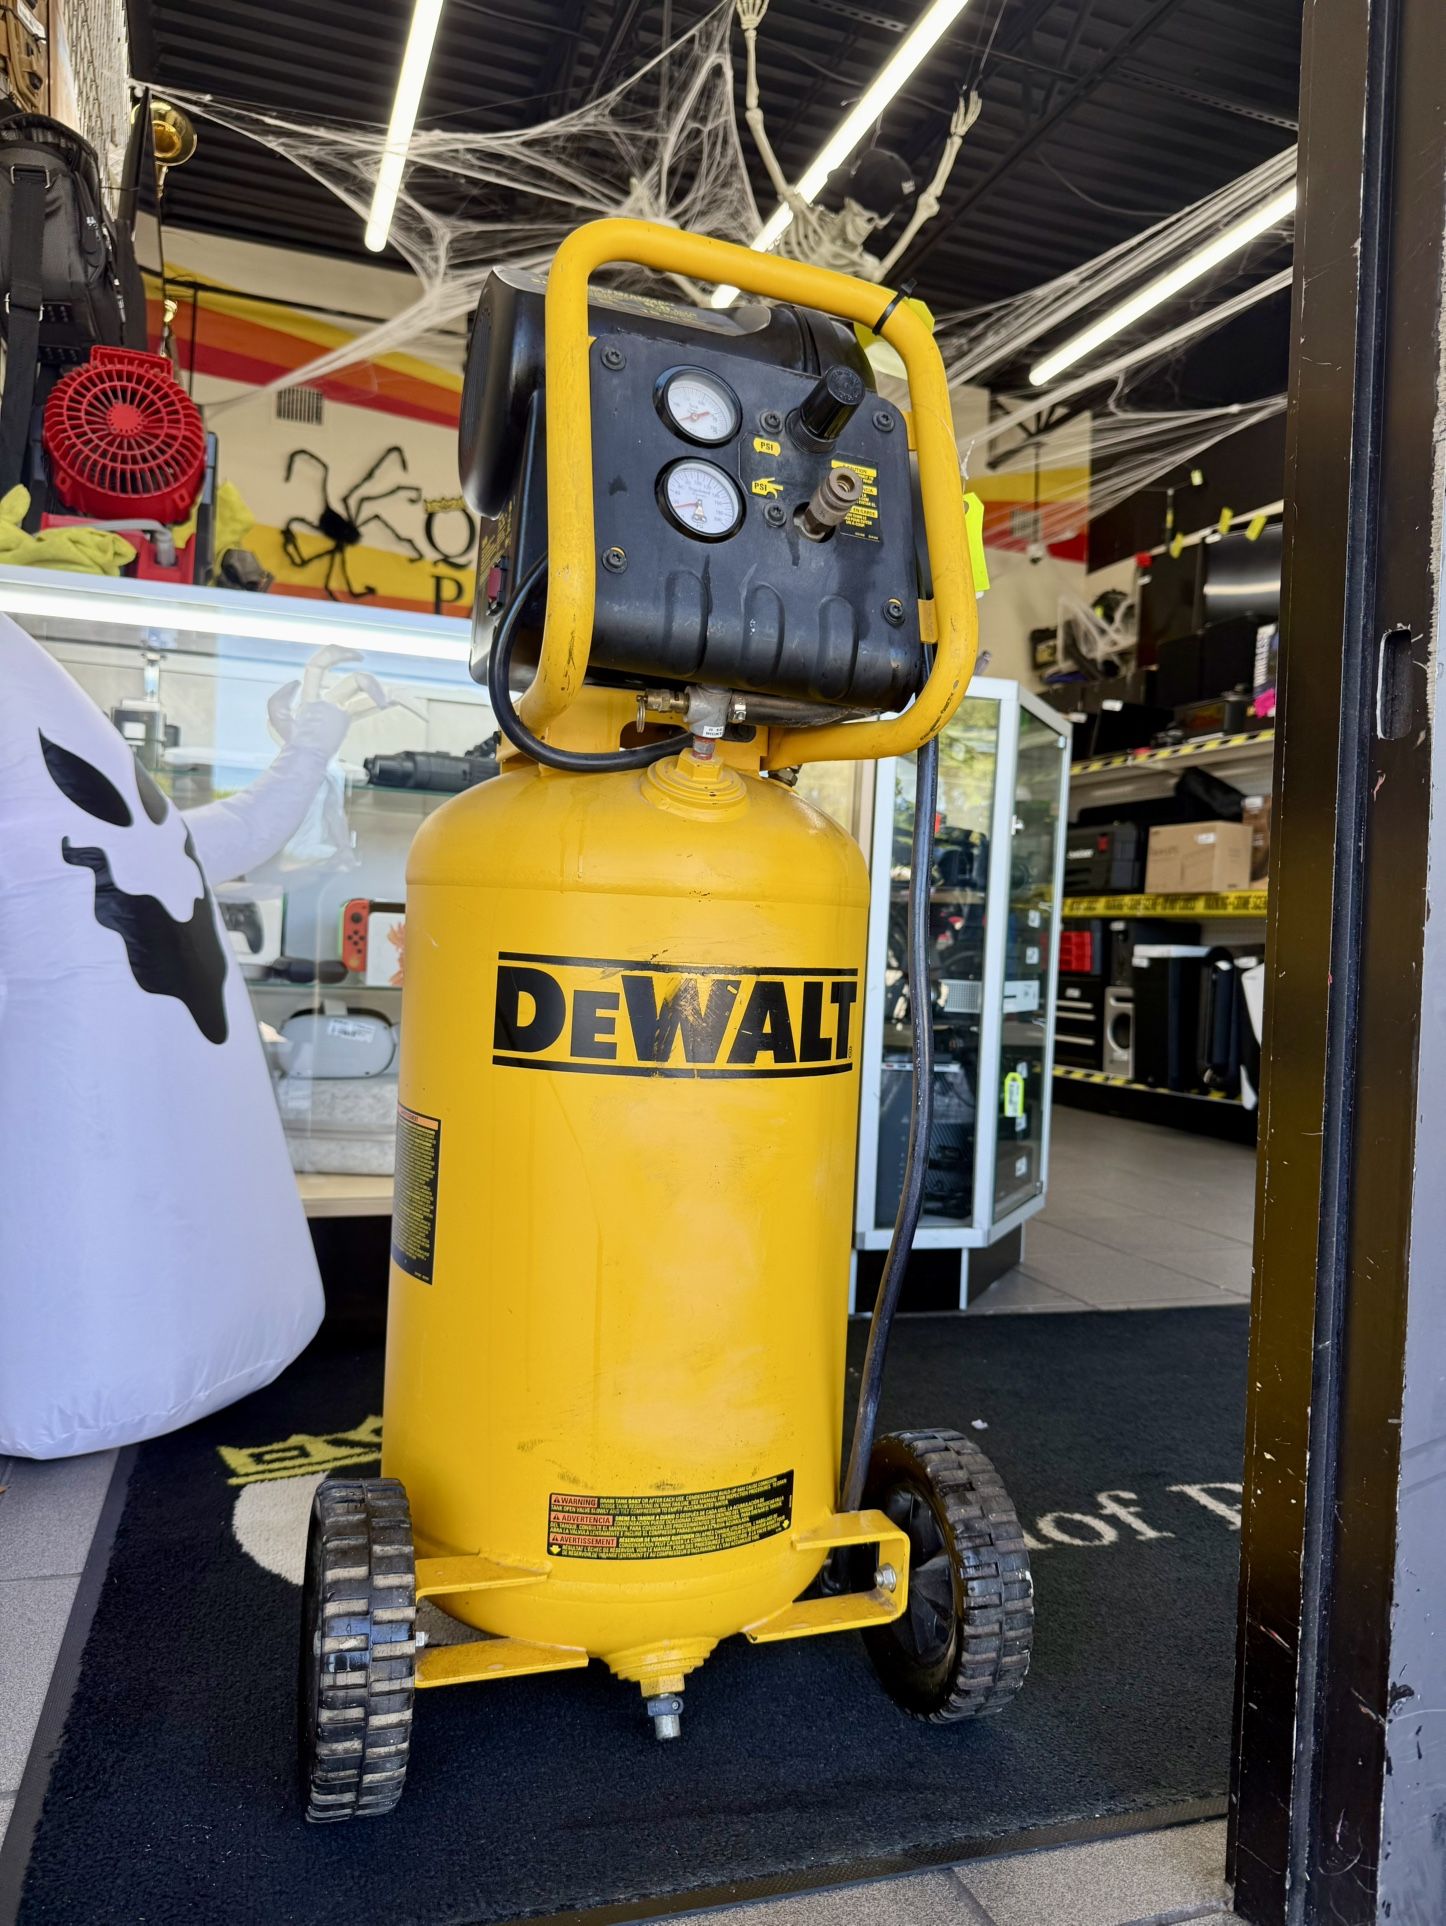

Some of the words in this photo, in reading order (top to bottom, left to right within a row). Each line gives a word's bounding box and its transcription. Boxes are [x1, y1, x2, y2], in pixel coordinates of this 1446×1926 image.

[760, 441, 774, 451] PSI
[754, 482, 768, 492] PSI
[493, 966, 857, 1063] DEWALT
[560, 1497, 595, 1505] WARNING
[561, 1514, 610, 1523] ADVERTENCIA
[1035, 1489, 1176, 1547] of
[559, 1535, 614, 1545] AVERTISSEMENT
